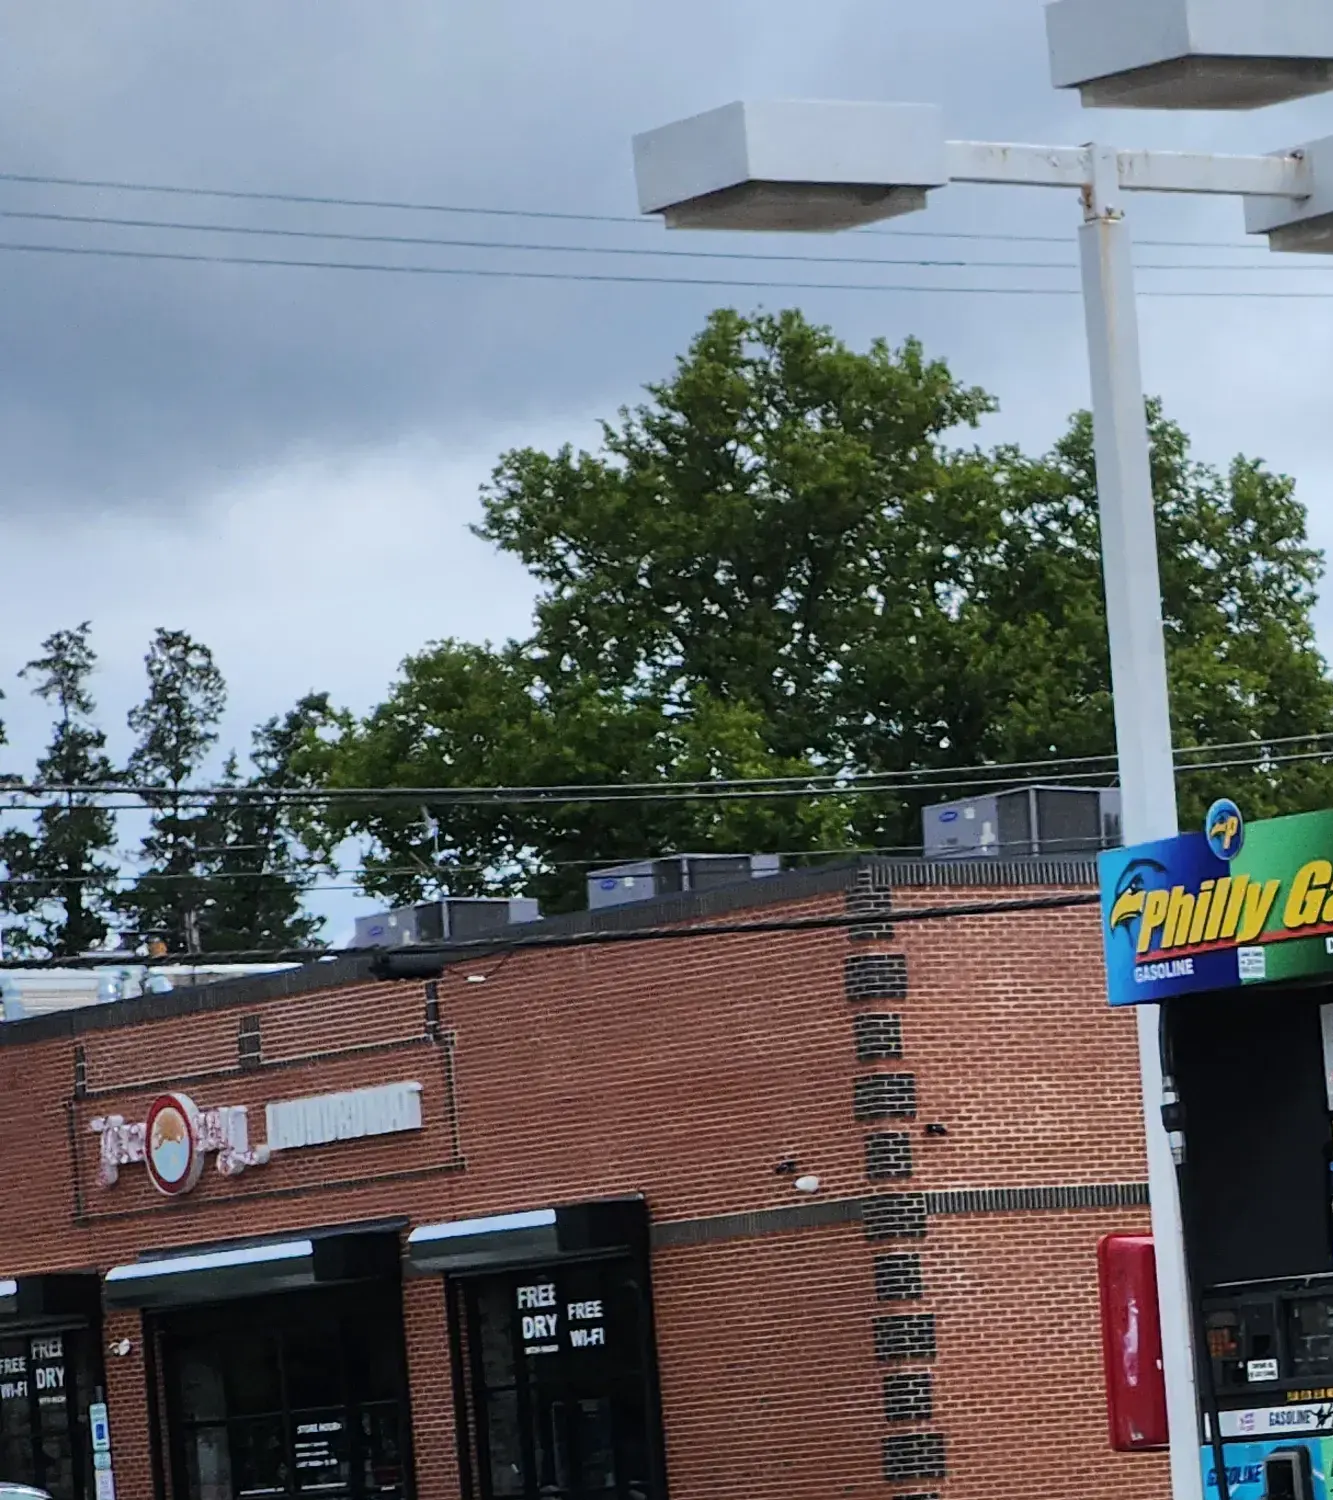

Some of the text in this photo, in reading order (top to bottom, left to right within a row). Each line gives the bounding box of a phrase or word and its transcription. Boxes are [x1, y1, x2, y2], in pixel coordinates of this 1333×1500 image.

[1136, 874, 1281, 954] Philly
[1134, 957, 1195, 983] GASOLINE
[517, 1283, 556, 1309] FREE
[567, 1300, 603, 1320] FREE
[522, 1313, 557, 1339] DRY
[569, 1328, 604, 1347] WI-FI
[36, 1365, 65, 1390] DRY
[1269, 1408, 1312, 1427] GASOLINE
